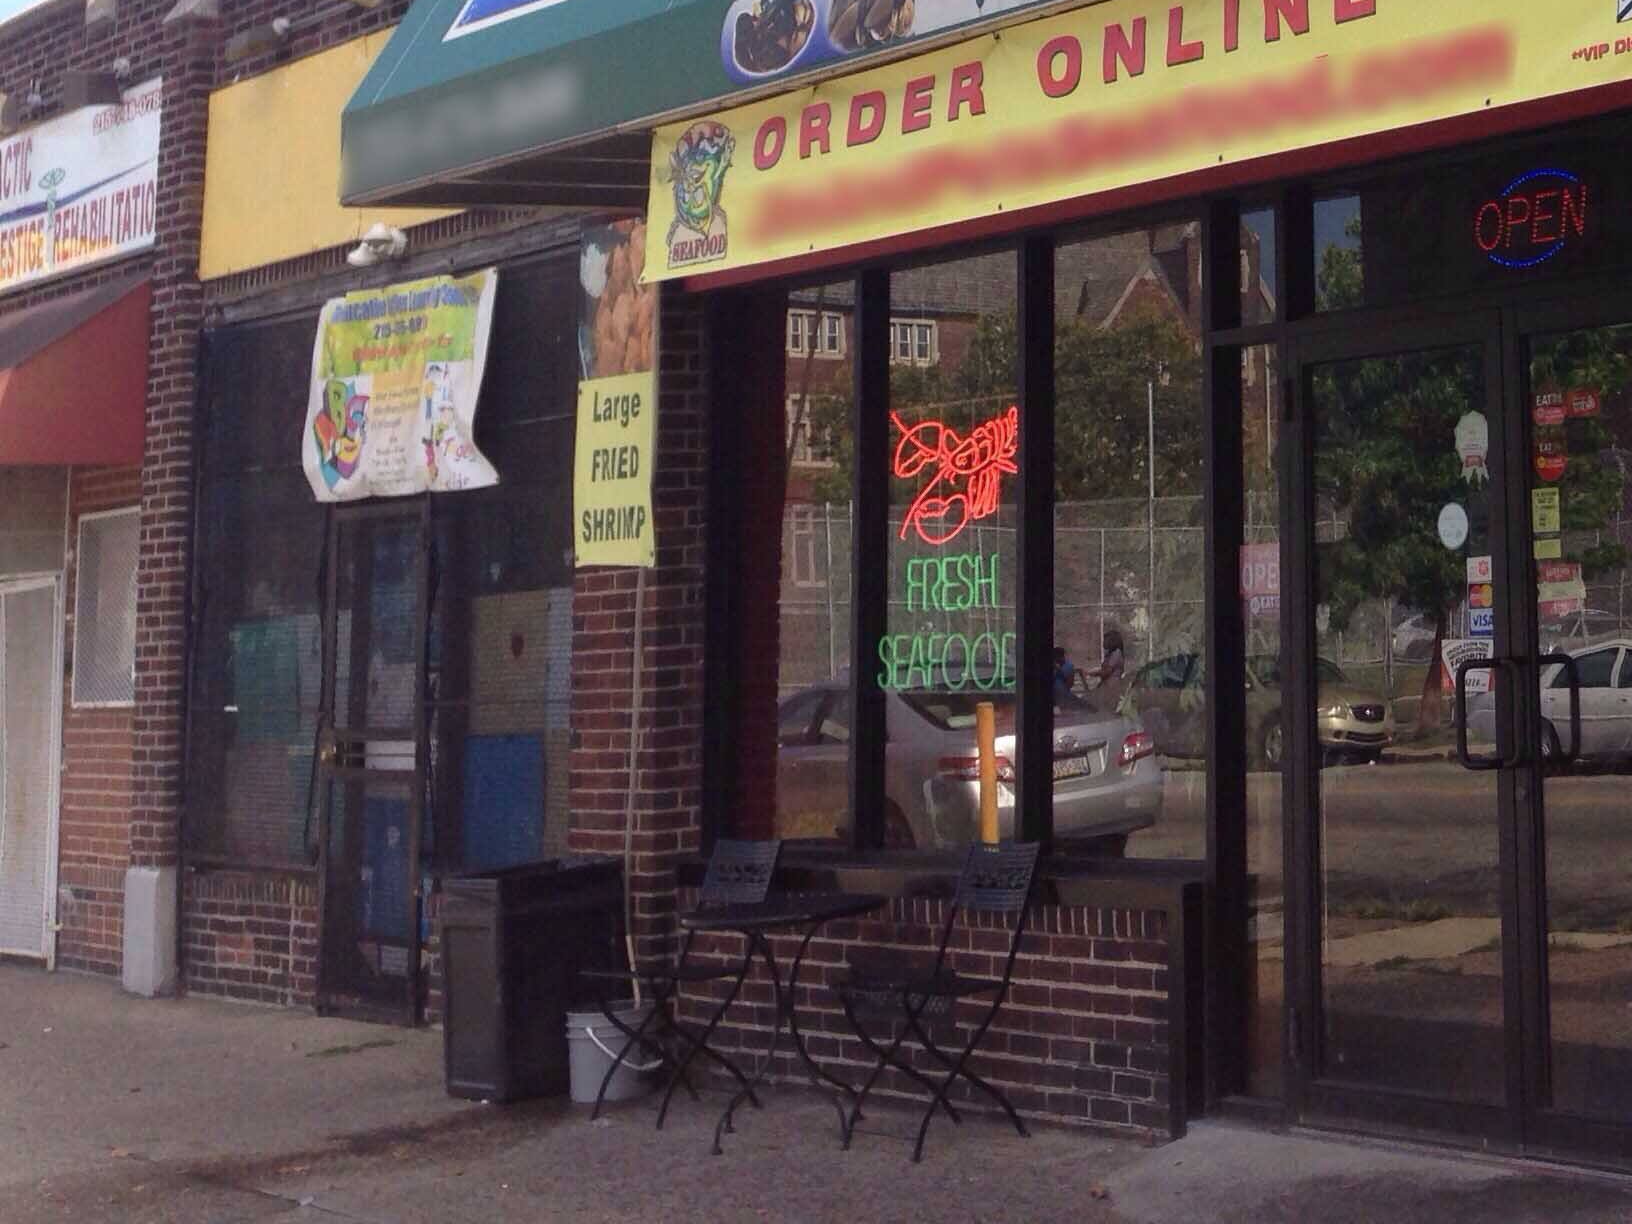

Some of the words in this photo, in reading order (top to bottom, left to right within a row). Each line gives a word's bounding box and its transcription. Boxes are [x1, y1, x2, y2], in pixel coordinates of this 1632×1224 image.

[753, 61, 985, 170] ORDER
[0, 136, 33, 199] CTIC
[1475, 184, 1588, 251] OPEN
[592, 391, 641, 427] Large
[591, 444, 640, 482] FRIED
[582, 505, 646, 544] SHRIMP
[907, 552, 1000, 612] FRESH
